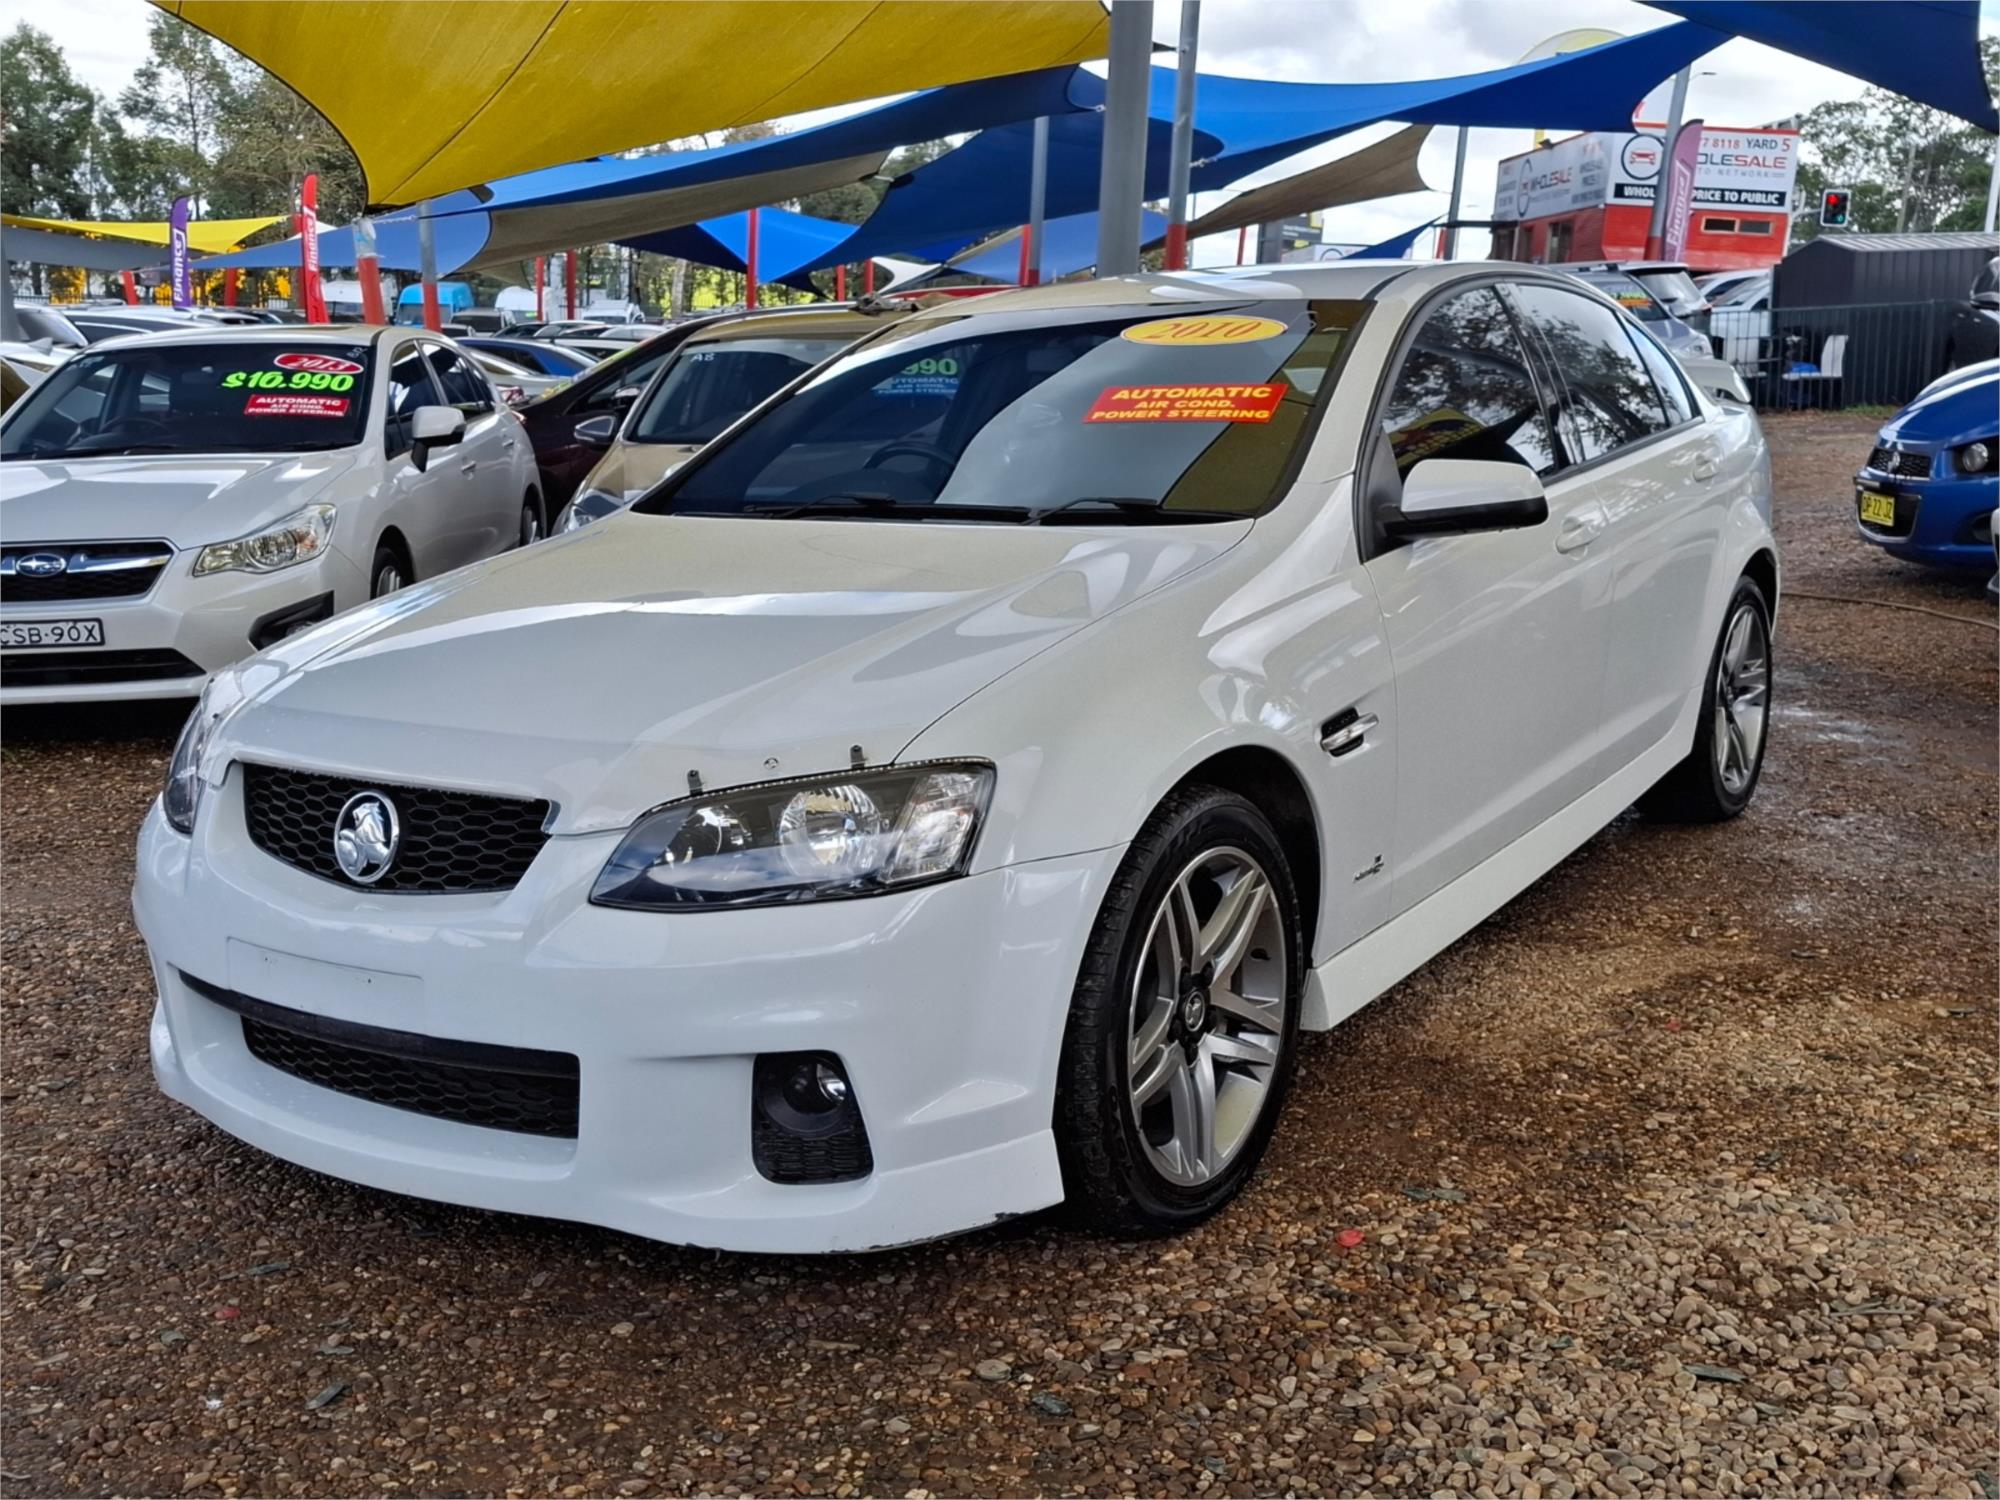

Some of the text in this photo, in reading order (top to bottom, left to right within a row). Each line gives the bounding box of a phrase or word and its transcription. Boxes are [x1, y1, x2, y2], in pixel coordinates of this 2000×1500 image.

[1712, 138, 1741, 149] 8118
[1746, 138, 1778, 150] YARD
[1781, 138, 1791, 152] 5
[1691, 189, 1721, 201] PRICE
[1724, 191, 1738, 202] TO
[1740, 192, 1780, 204] PUBLIC
[1665, 176, 1686, 246] Finance
[309, 219, 318, 272] Finance
[173, 237, 184, 302] Finance
[1147, 321, 1262, 340] 2010
[1112, 387, 1272, 399] AUTOMATIC
[256, 397, 342, 406] AUTOMATIC
[1134, 400, 1236, 409] AIR COND.
[289, 409, 345, 417] STEERING
[1092, 410, 1270, 419] POWER STEERING
